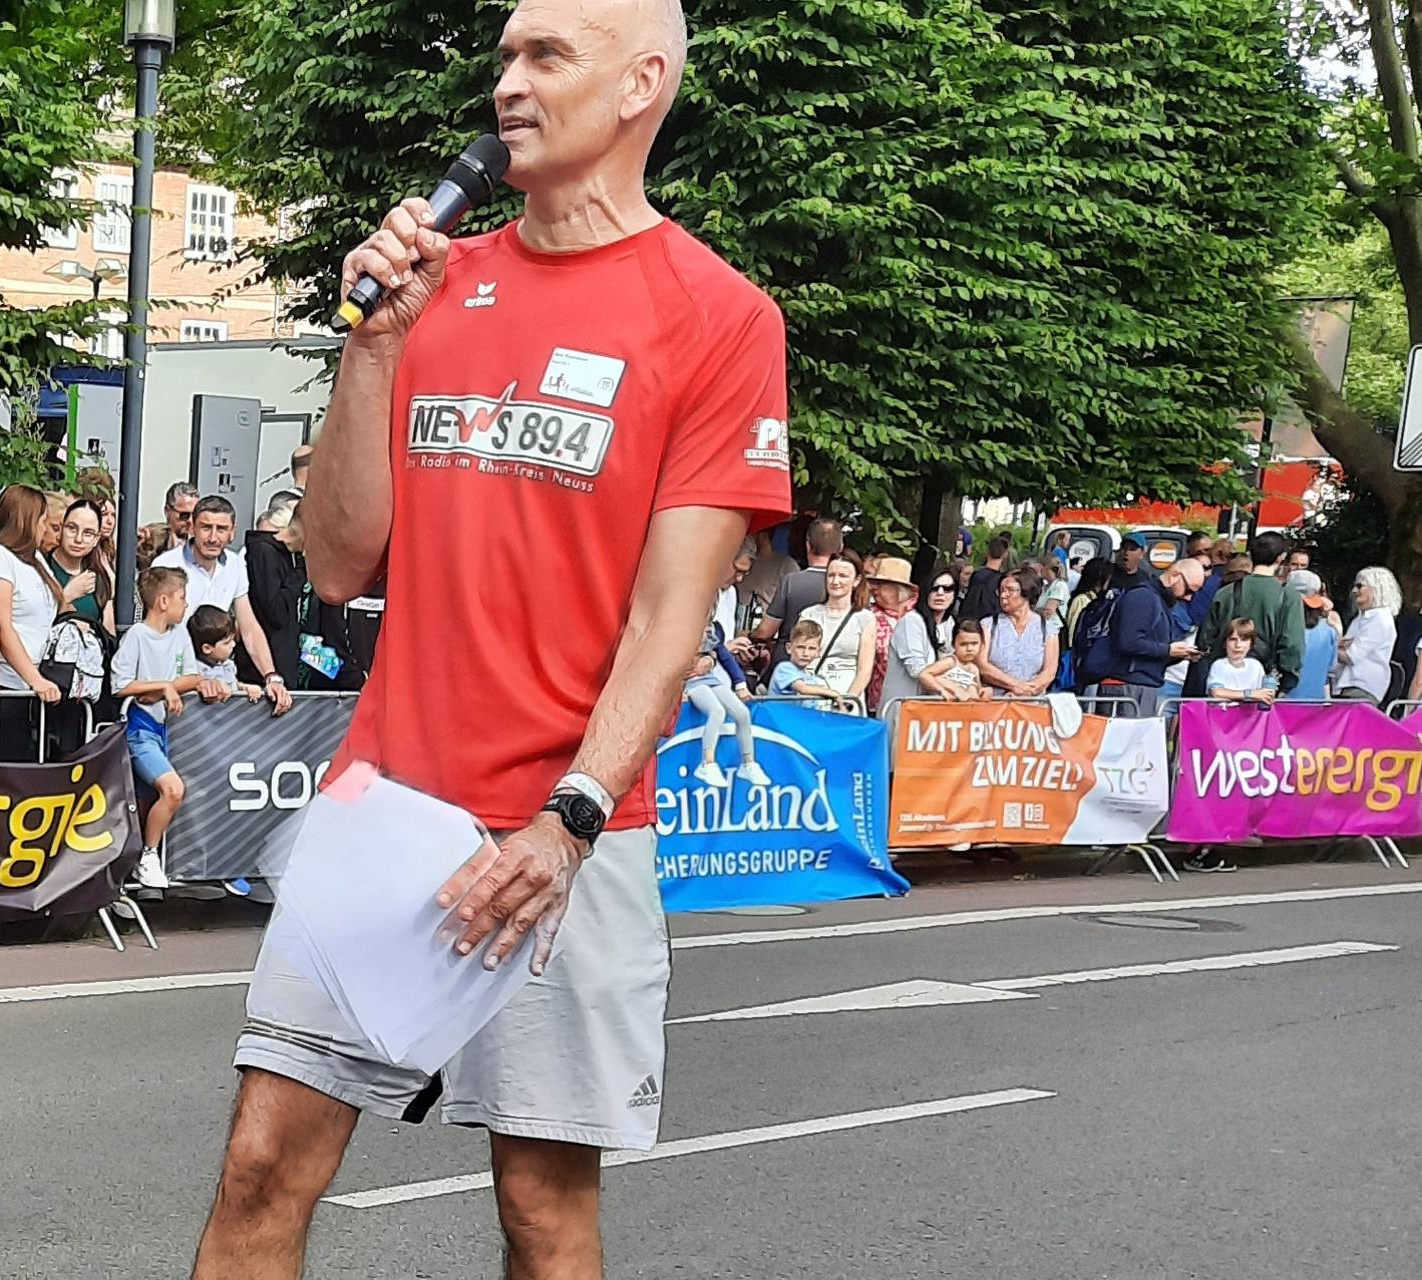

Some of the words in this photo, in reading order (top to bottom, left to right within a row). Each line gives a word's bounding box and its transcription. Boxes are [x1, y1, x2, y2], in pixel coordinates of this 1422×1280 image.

[411, 390, 514, 450] NEWS
[518, 411, 592, 462] 89.4
[420, 454, 451, 469] Radio
[454, 454, 471, 468] im
[477, 459, 544, 481] Rhein-Kreis
[552, 470, 594, 492] Neuss
[906, 719, 963, 752] MIT
[1191, 733, 1422, 812] westenergi
[656, 765, 840, 836] einLand
[656, 848, 833, 879] CHERUNGSGRUPPE
